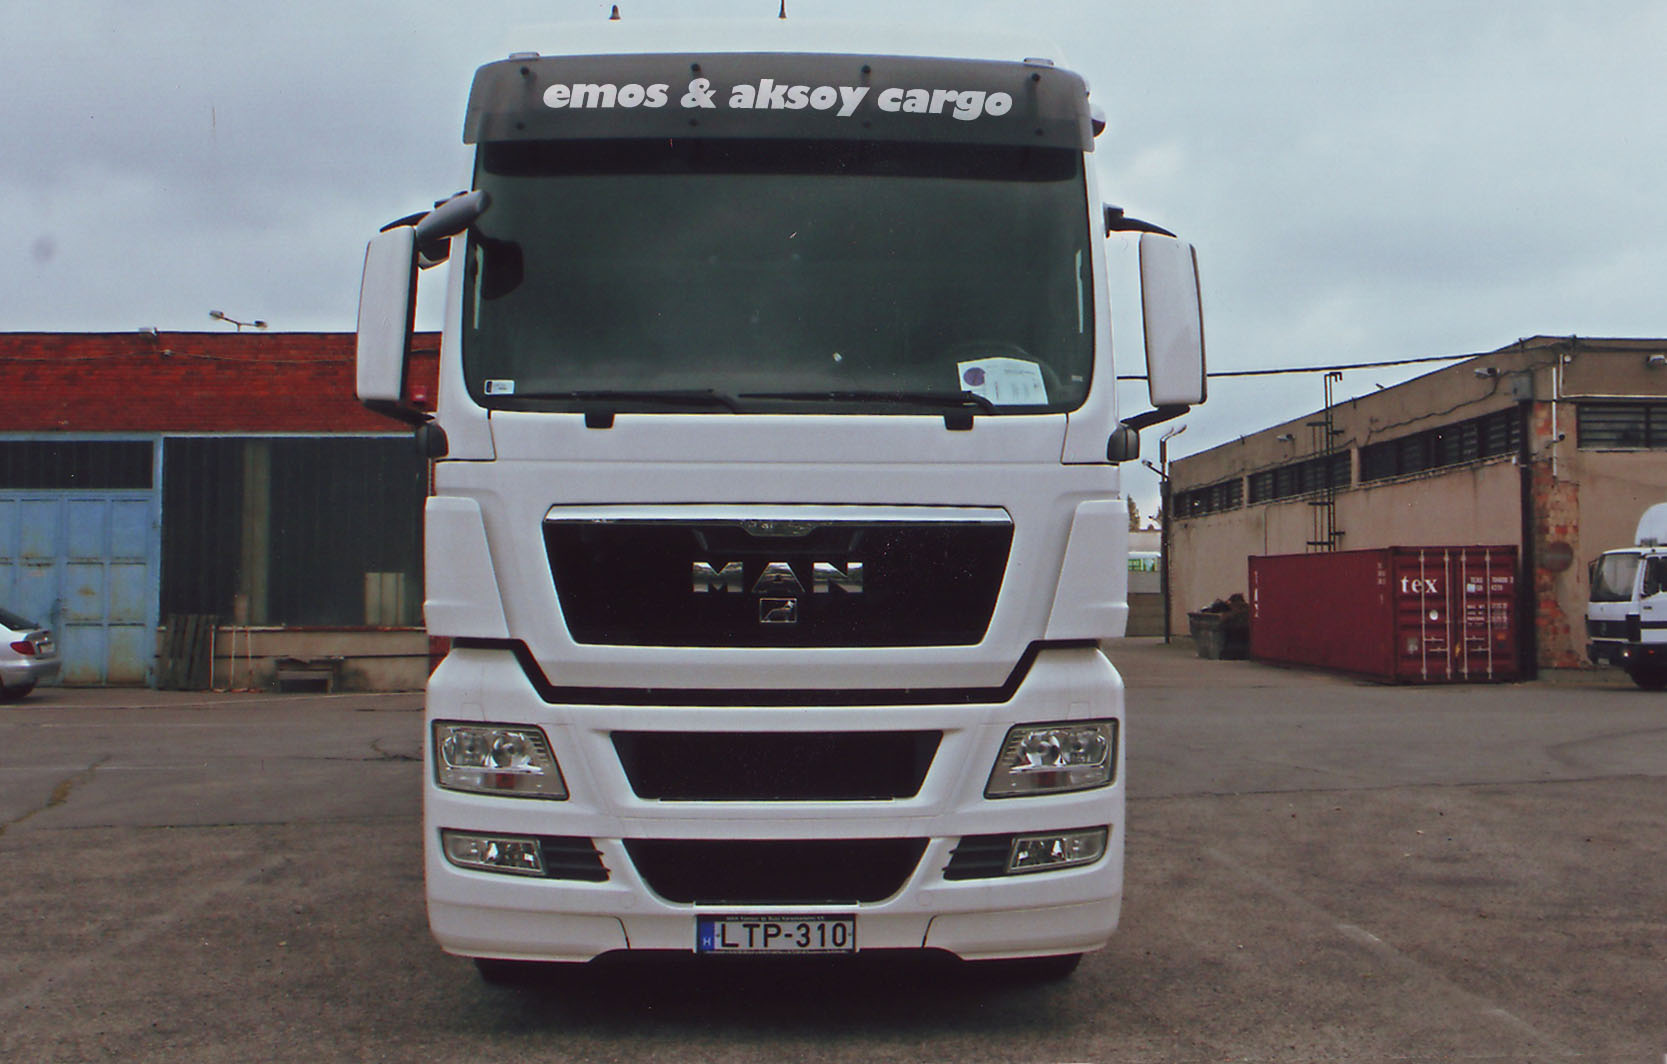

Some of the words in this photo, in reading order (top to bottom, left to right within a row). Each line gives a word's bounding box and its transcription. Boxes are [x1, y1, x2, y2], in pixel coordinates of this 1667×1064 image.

[543, 83, 670, 109] emos
[680, 77, 717, 109] &
[729, 78, 870, 117] aksoy
[878, 87, 1013, 121] cargo
[692, 561, 863, 593] MAN
[1400, 576, 1438, 593] tex
[721, 922, 847, 948] LTP-310
